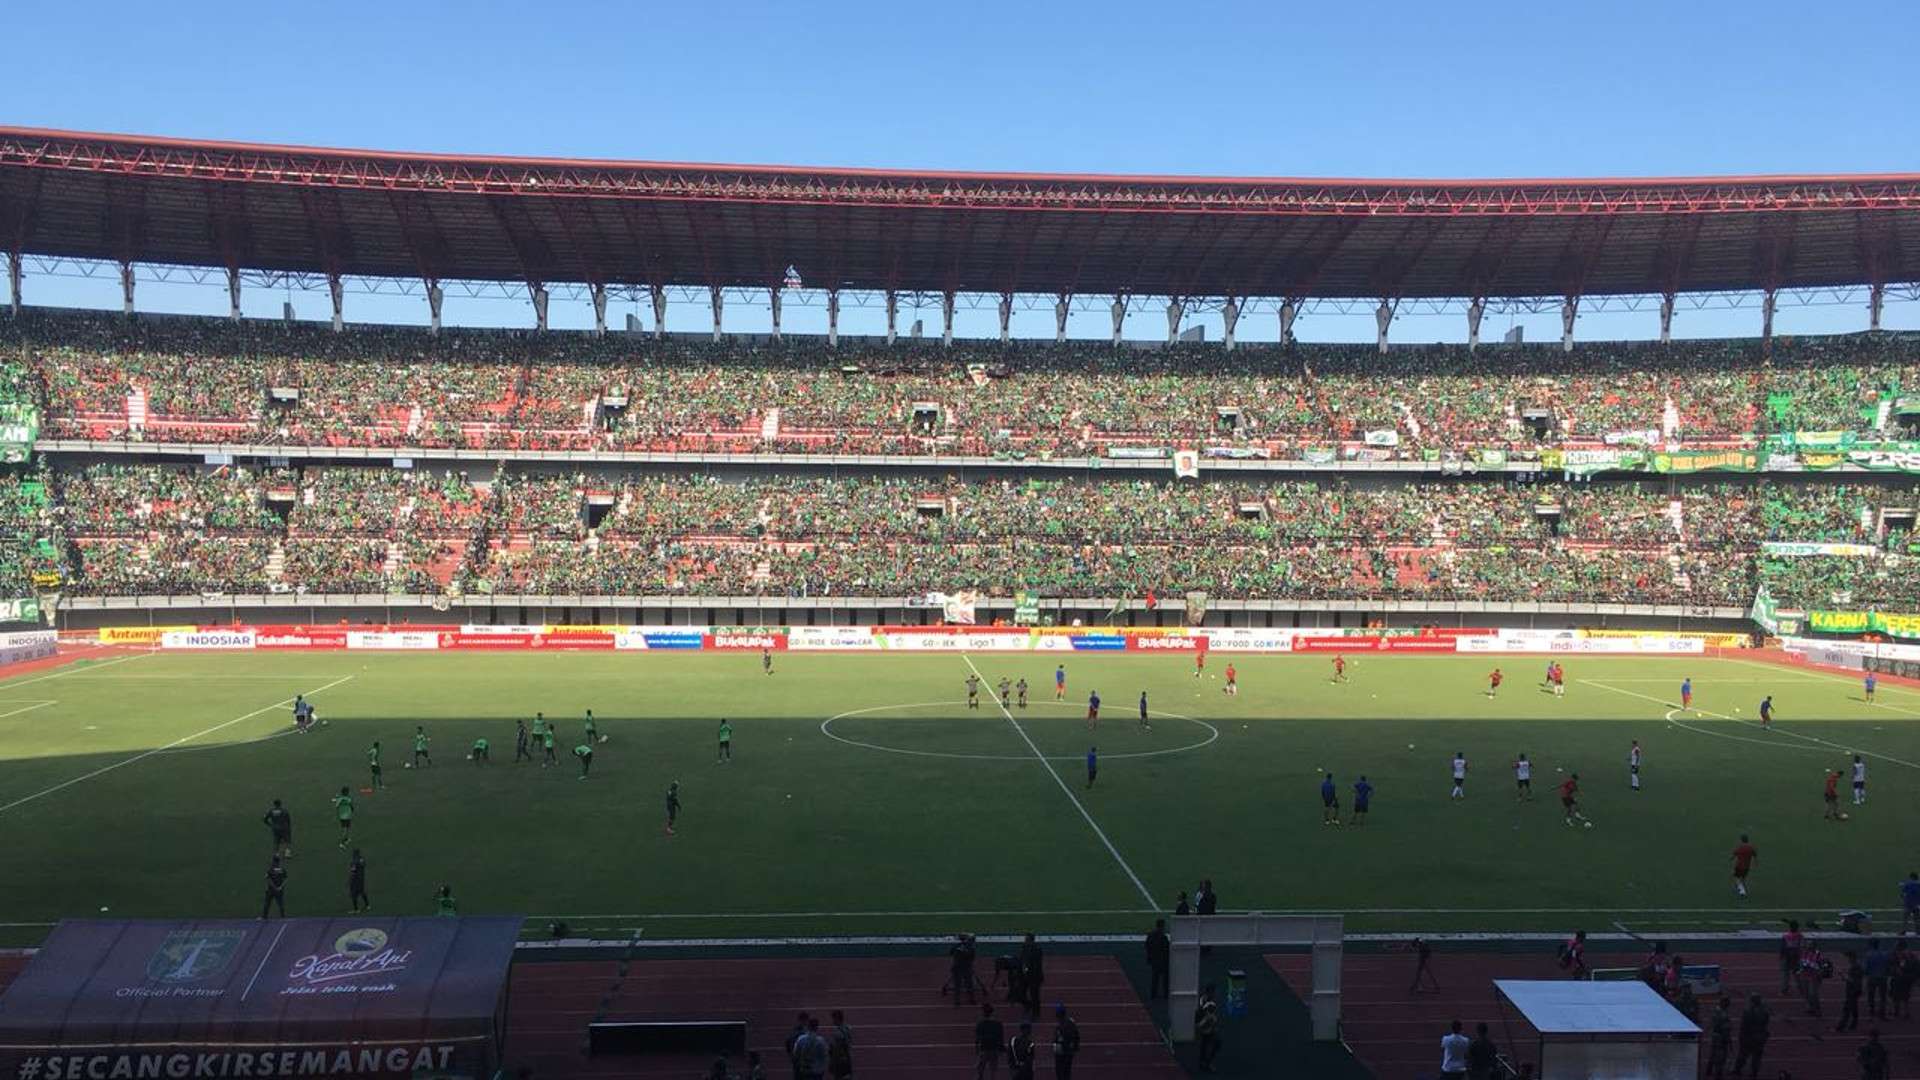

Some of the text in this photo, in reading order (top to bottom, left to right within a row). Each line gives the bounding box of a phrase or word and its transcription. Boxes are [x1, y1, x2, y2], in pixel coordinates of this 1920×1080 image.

[1811, 611, 1868, 628] KARNA
[186, 635, 250, 645] INDOSIAR
[116, 986, 225, 998] Official Partner
[18, 1045, 455, 1080] #SECANGKIRSEMANGAT
